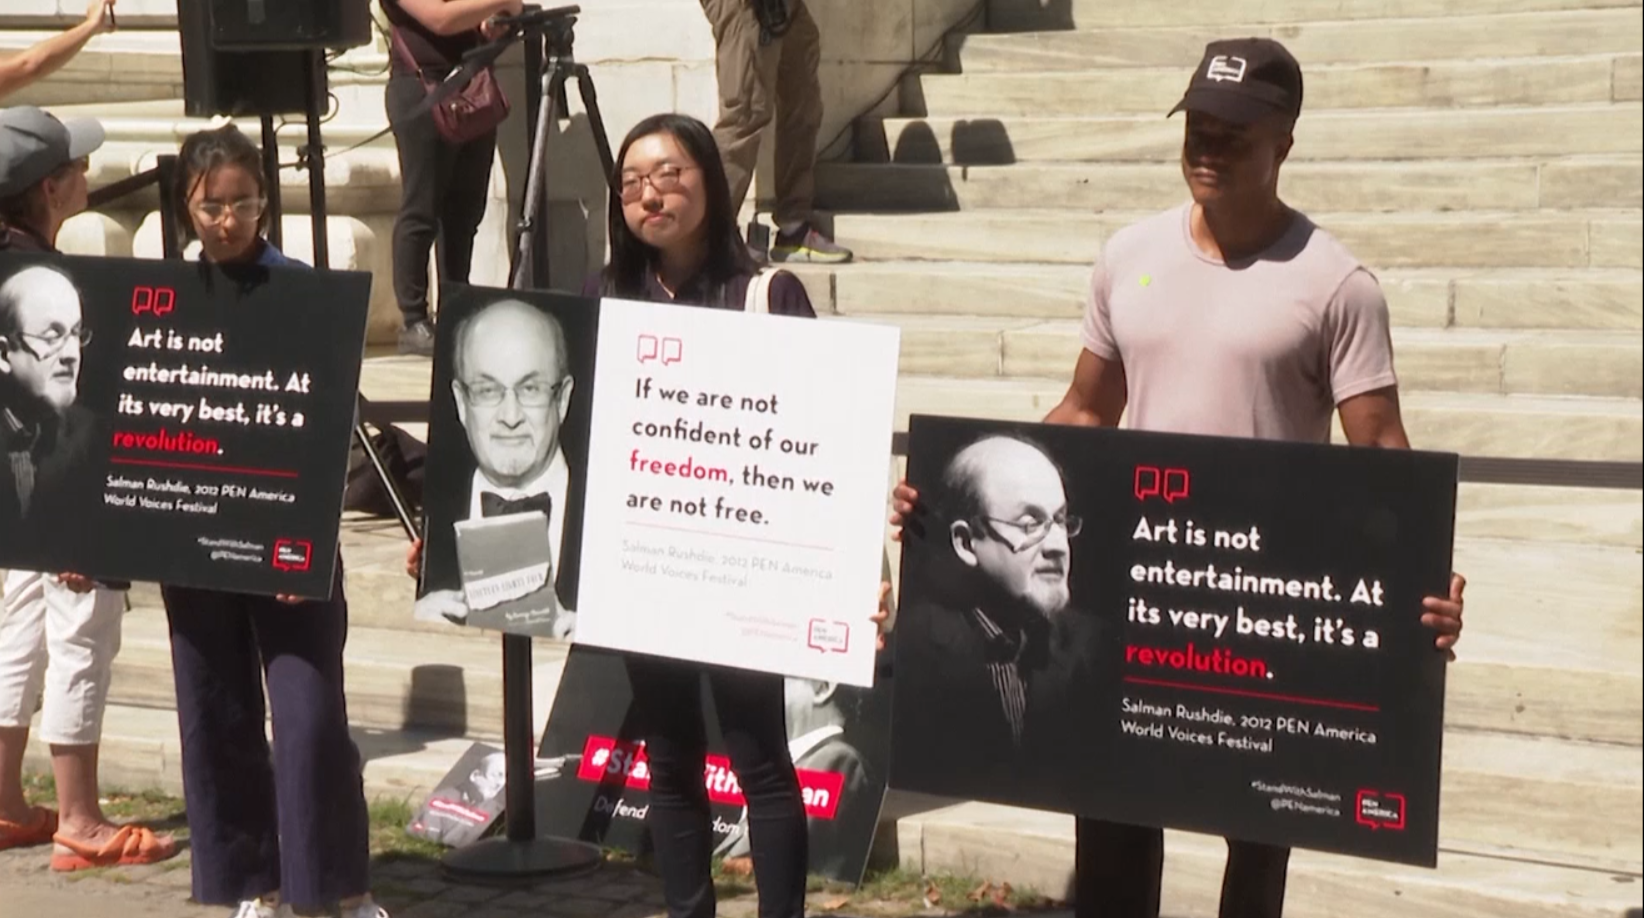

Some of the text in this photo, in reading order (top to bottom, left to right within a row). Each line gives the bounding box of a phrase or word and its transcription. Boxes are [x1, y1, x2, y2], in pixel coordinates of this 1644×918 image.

[127, 327, 224, 354] Art is not
[122, 361, 311, 394] entertainment. At
[117, 393, 305, 428] its very best, it's a
[635, 376, 778, 415] If we are not
[112, 427, 224, 456] revolution.
[632, 417, 819, 456] confident of our
[106, 474, 296, 504] Salman Rushdie, 2012 PEN America
[629, 448, 834, 497] freedom, then we
[103, 492, 219, 515] World Voices Festival
[626, 493, 769, 525] are not free.
[1132, 516, 1261, 552] Art is not
[621, 539, 665, 556] Salman
[721, 555, 748, 569] 2012
[751, 556, 779, 571] PEN
[781, 562, 833, 581] America
[621, 560, 748, 588] World Voices Festival
[1130, 559, 1384, 607] entertainment. At
[1128, 597, 1379, 649] its very best, it's a
[1125, 642, 1274, 680] revolution.
[1120, 719, 1273, 753] World Voices Festival
[1121, 697, 1172, 718] Salman
[1240, 715, 1273, 731] 2012
[1276, 716, 1310, 734] PEN
[1313, 722, 1377, 744] America
